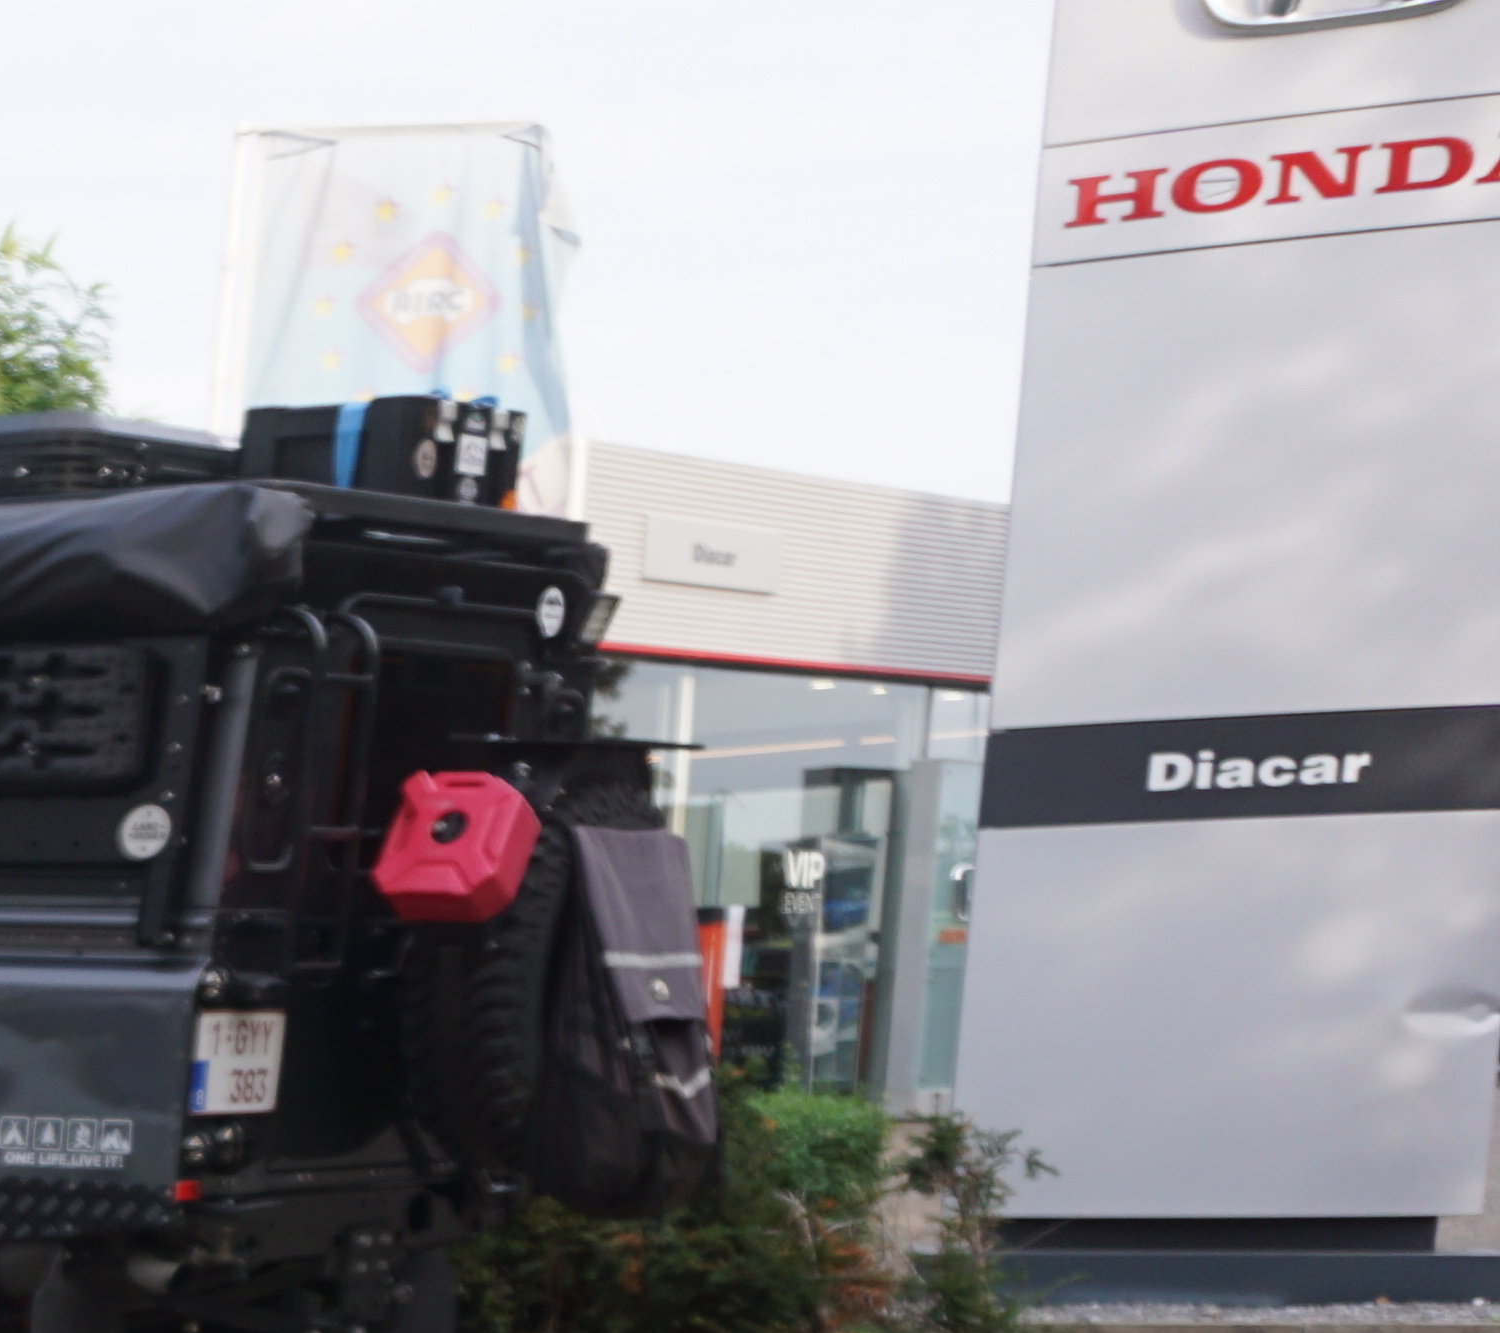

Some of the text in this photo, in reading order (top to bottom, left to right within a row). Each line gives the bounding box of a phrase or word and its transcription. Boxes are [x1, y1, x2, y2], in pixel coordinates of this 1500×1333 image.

[1064, 136, 1500, 229] HOND
[1144, 749, 1373, 793] Diacar
[783, 849, 826, 890] VIP
[229, 1067, 268, 1103] 383
[3, 1151, 35, 1165] ONE
